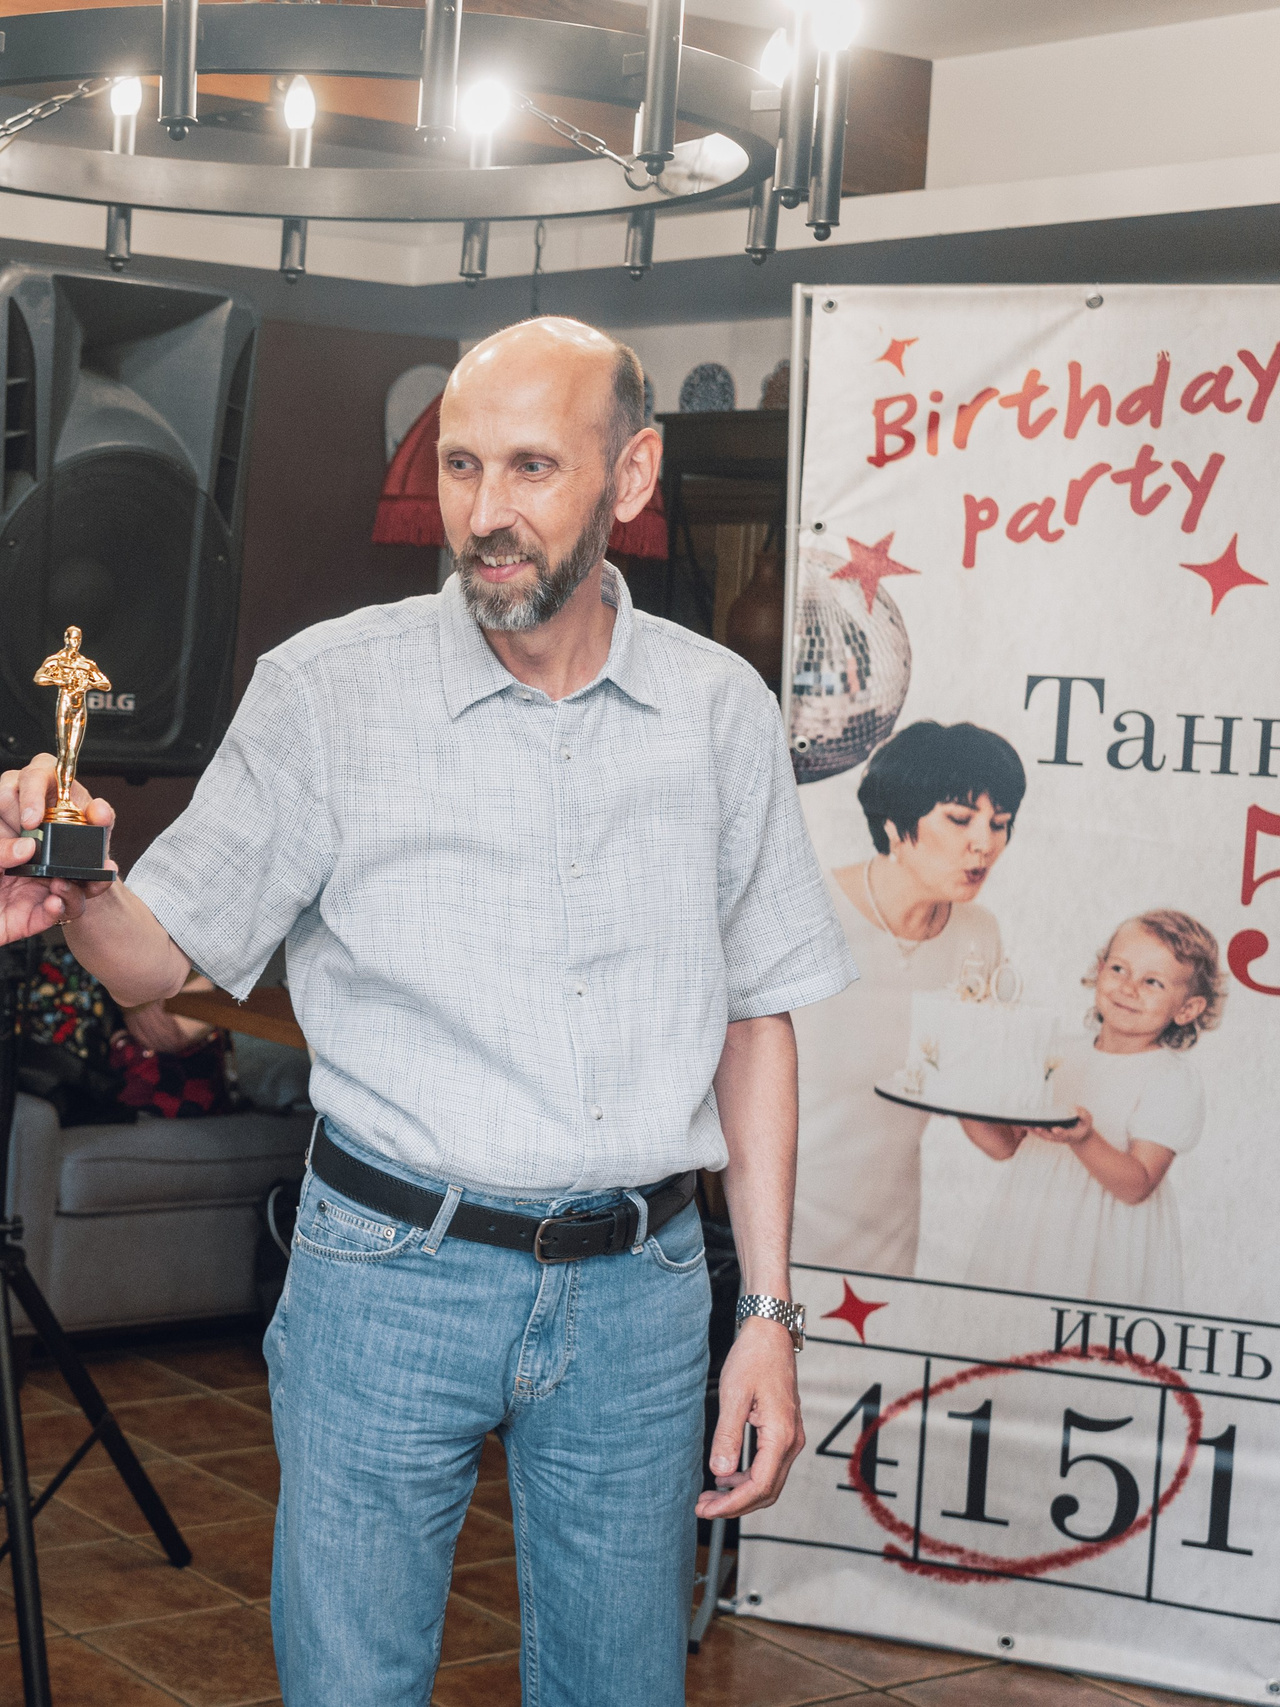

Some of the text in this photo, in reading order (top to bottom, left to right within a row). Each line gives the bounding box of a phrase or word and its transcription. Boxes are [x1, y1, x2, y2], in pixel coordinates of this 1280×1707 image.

[866, 341, 1280, 468] Birthday
[962, 444, 1225, 570] party
[87, 691, 135, 711] BLG
[816, 1382, 1253, 1556] 4 15 1
